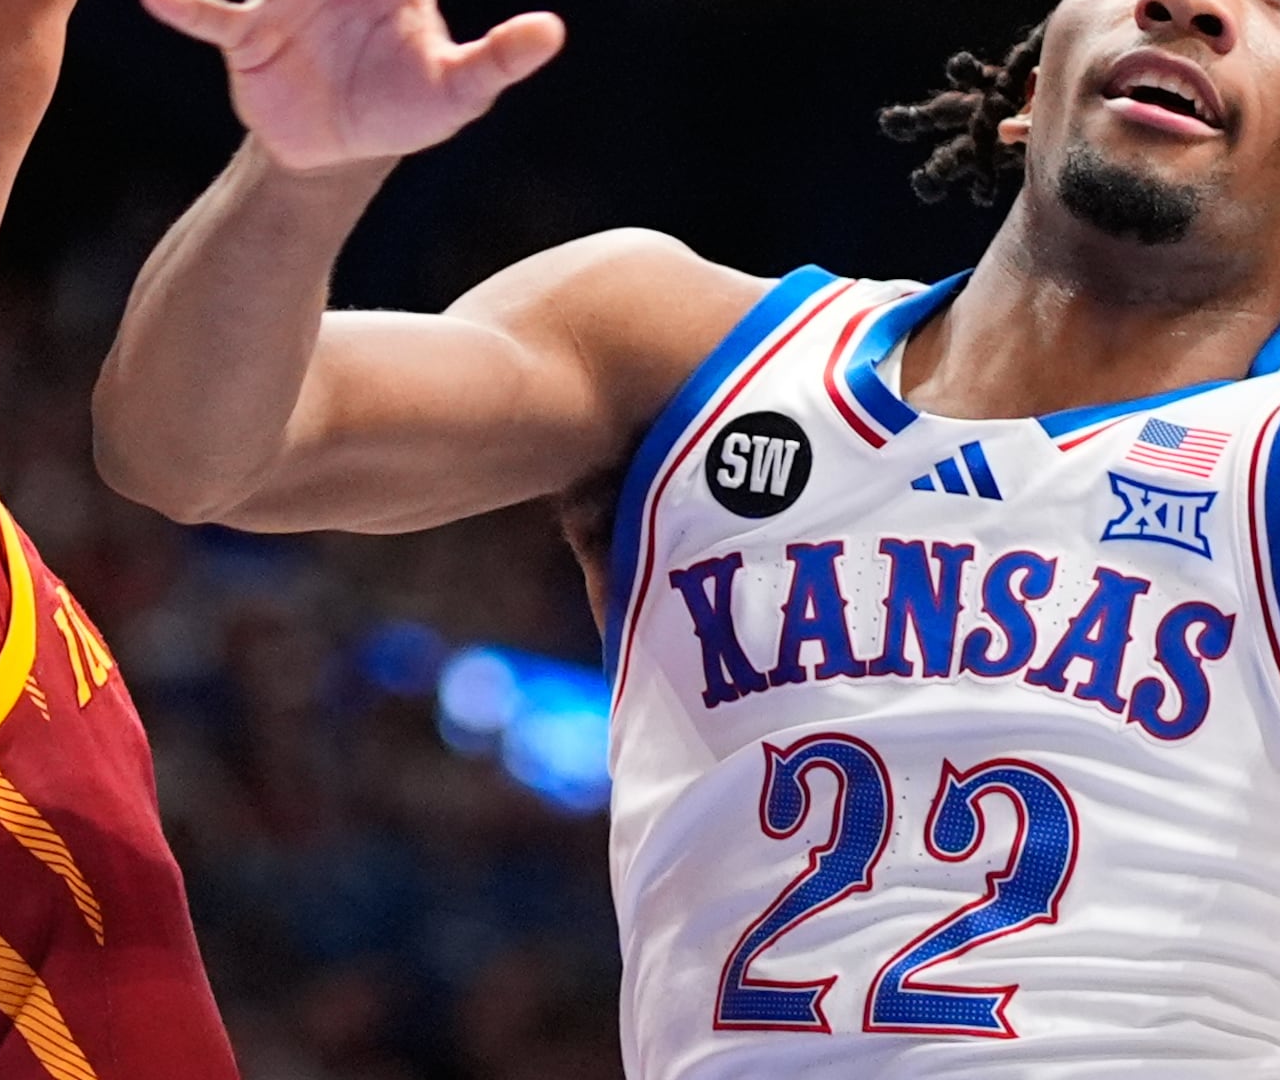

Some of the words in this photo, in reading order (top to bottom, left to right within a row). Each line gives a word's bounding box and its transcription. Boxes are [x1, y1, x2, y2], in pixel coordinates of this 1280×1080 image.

[717, 432, 801, 497] SW
[1100, 470, 1218, 561] XII
[669, 538, 1236, 741] KANSAS
[713, 732, 1080, 1039] 22
